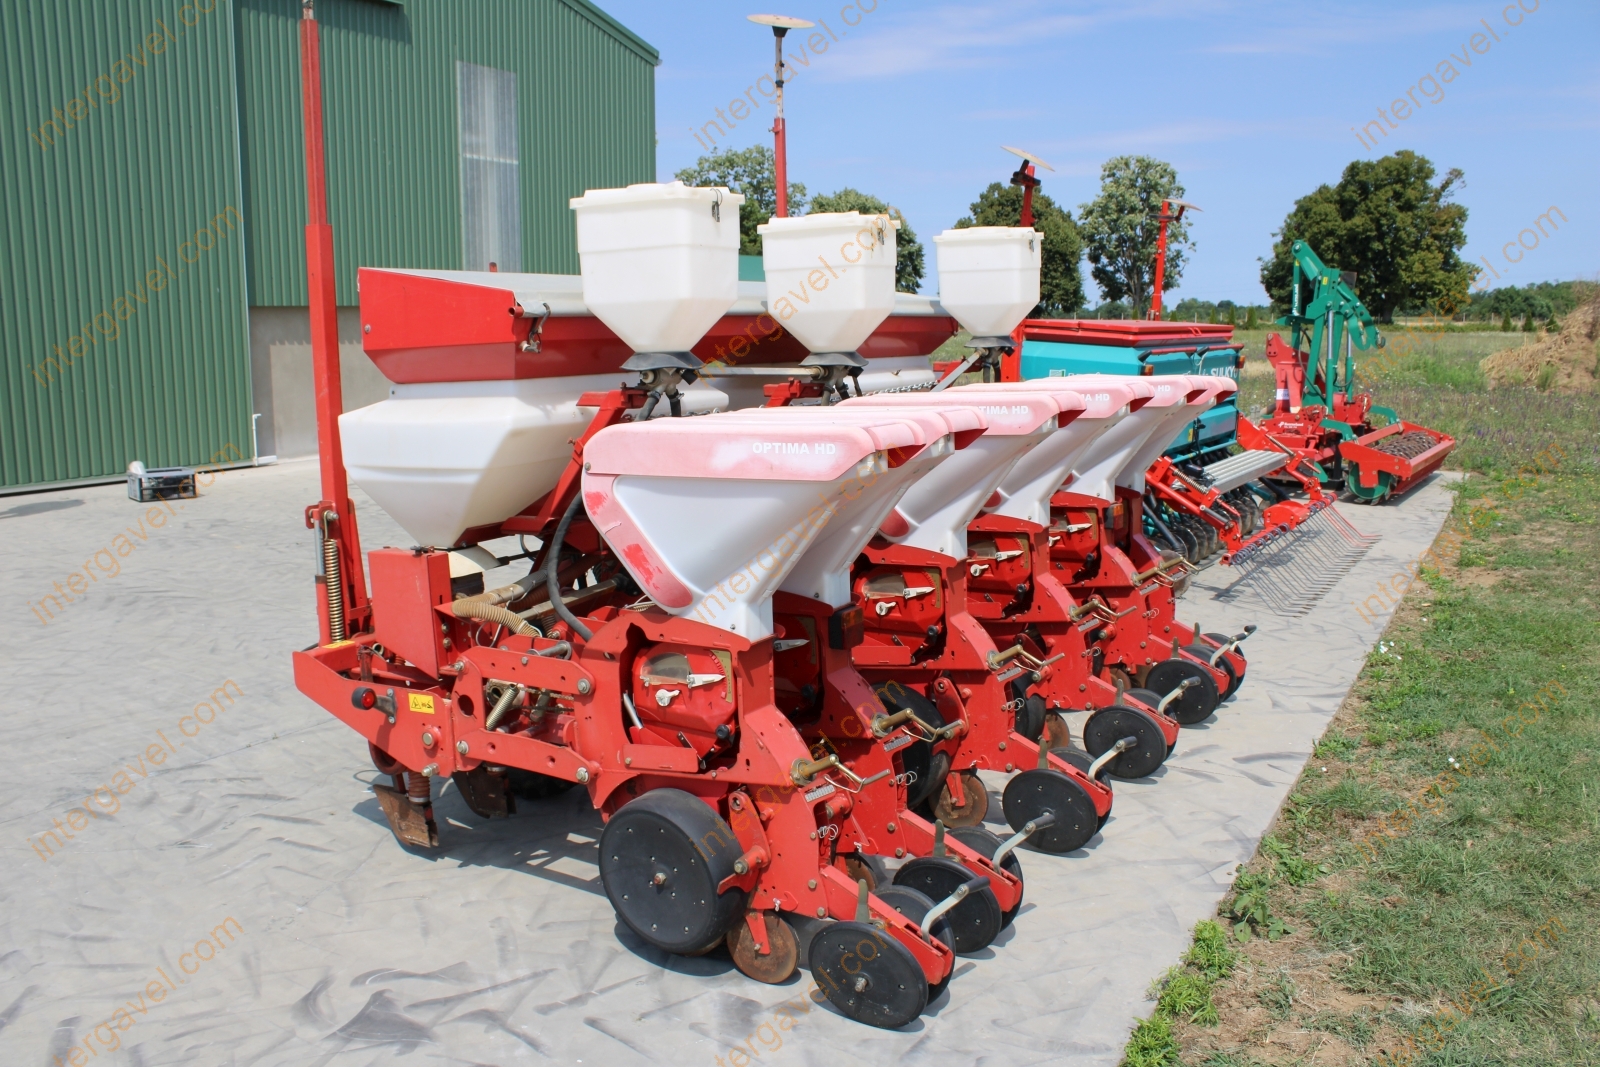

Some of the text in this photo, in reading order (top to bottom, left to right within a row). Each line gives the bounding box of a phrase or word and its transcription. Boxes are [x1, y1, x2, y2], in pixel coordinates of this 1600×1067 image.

[1095, 393, 1110, 402] HD
[978, 405, 1029, 415] TIMA HD
[752, 442, 836, 456] OPTIMA HD
[919, 603, 924, 612] 3
[708, 701, 713, 710] 1
